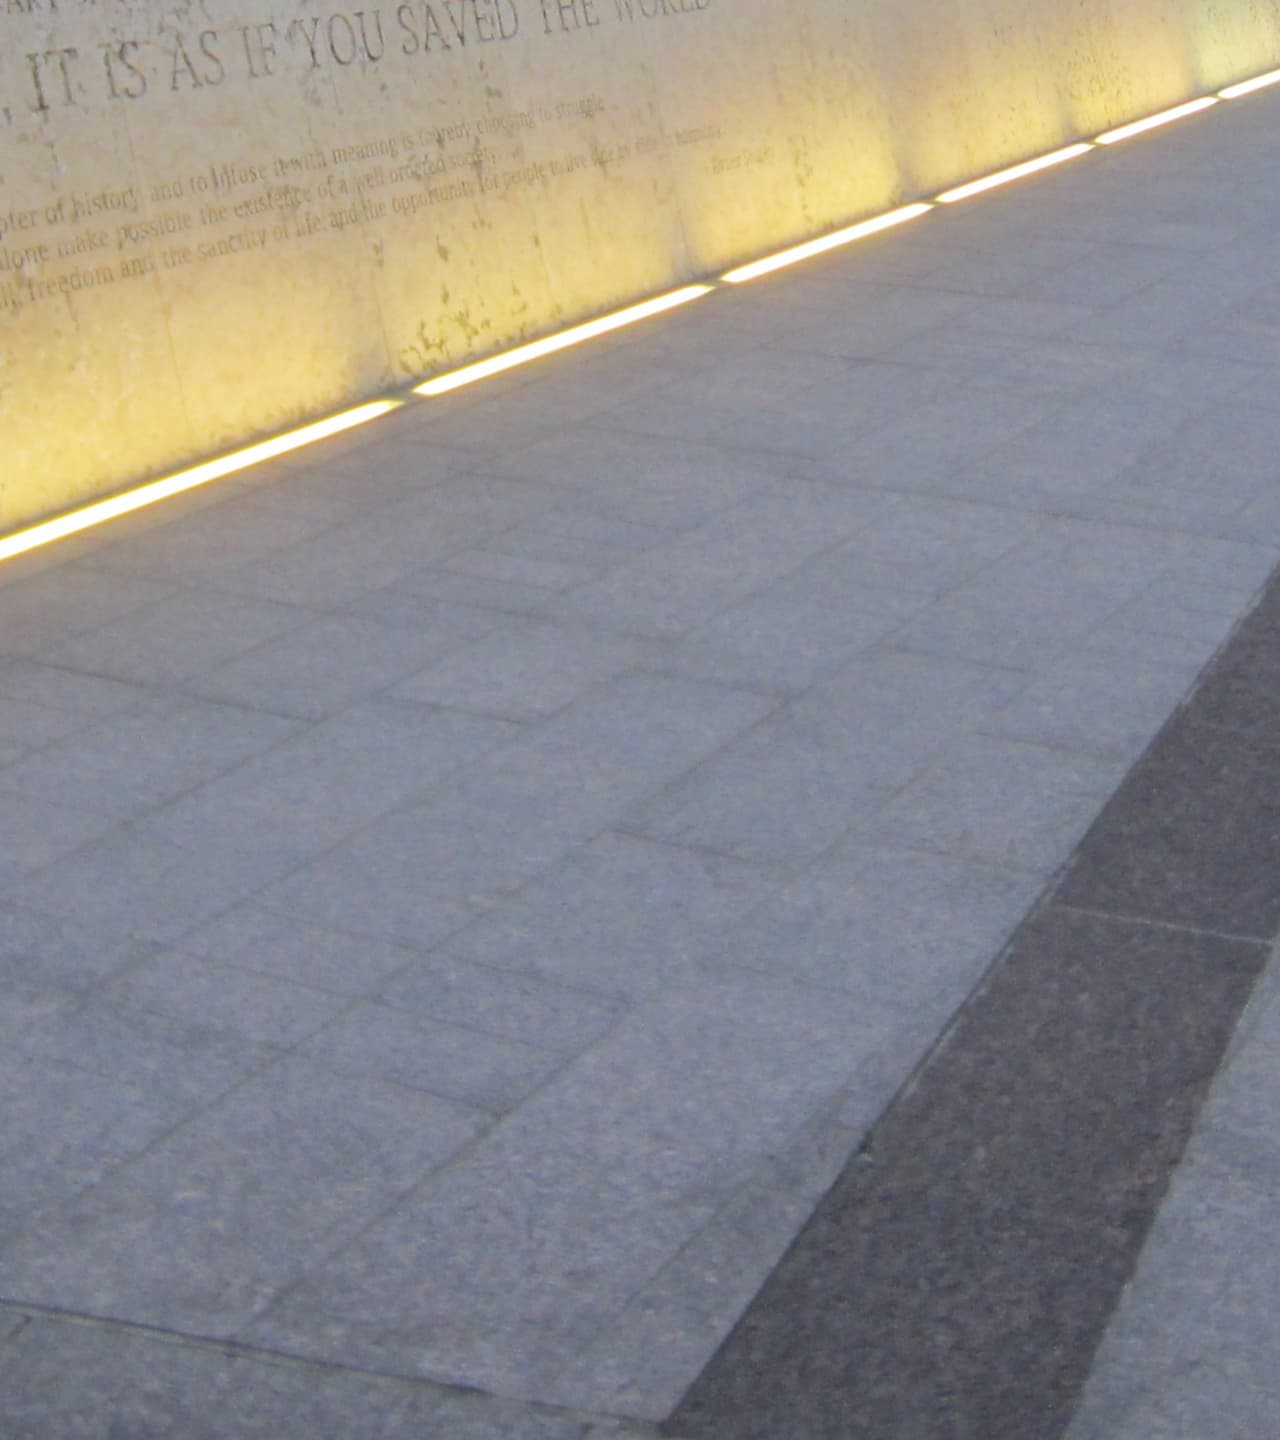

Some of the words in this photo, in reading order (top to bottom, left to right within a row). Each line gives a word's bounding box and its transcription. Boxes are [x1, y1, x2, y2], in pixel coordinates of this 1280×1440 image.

[25, 47, 79, 113] IT
[97, 39, 148, 100] IS
[170, 28, 226, 92] AS
[237, 22, 278, 79] IF
[290, 8, 386, 69] YOU
[43, 202, 67, 227] of
[69, 185, 138, 226] history
[150, 178, 185, 203] and
[189, 172, 209, 194] to
[331, 136, 399, 166] meaning
[56, 228, 110, 259] make
[116, 211, 193, 251] possible
[199, 203, 228, 227] the
[232, 183, 315, 221] existence
[25, 262, 116, 304] freedom
[120, 254, 156, 279] and
[161, 244, 193, 271] the
